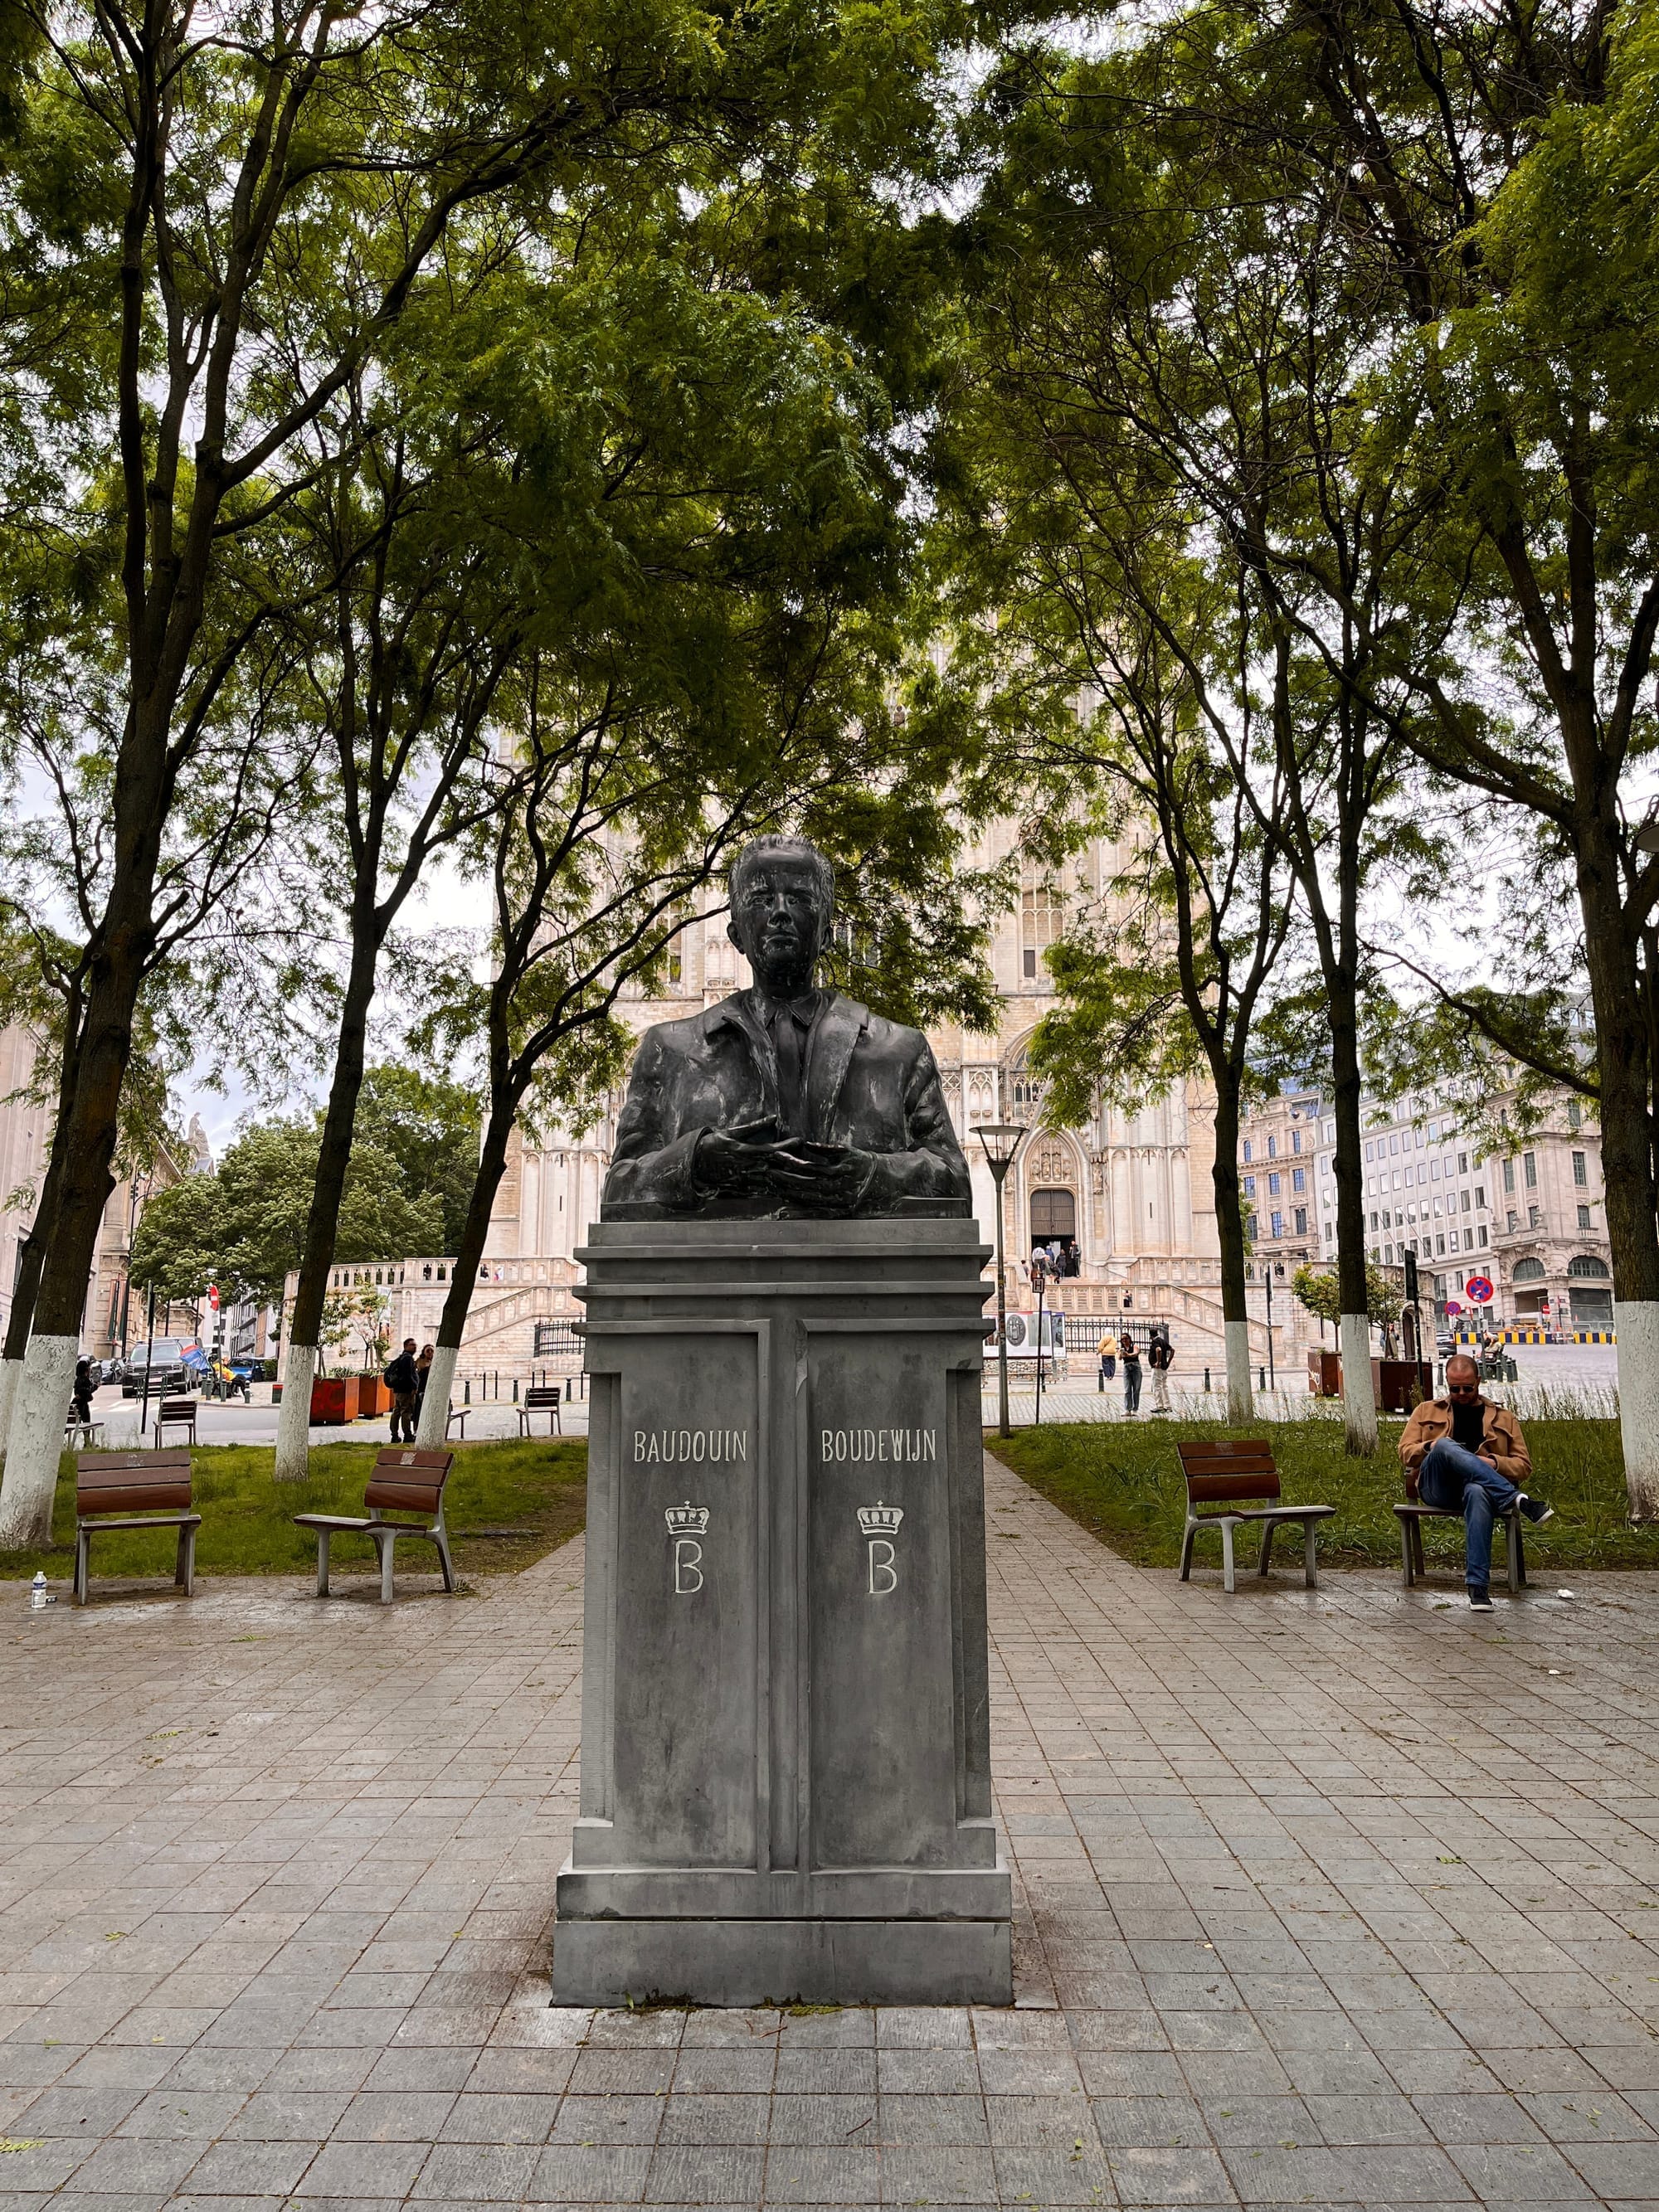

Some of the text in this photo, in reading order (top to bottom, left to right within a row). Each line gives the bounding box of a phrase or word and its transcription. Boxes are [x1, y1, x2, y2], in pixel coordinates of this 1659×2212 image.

[634, 1430, 747, 1462] BAUDOUIN
[821, 1429, 936, 1462] BOUDEWIJN
[675, 1540, 703, 1593] B
[868, 1539, 898, 1593] B
